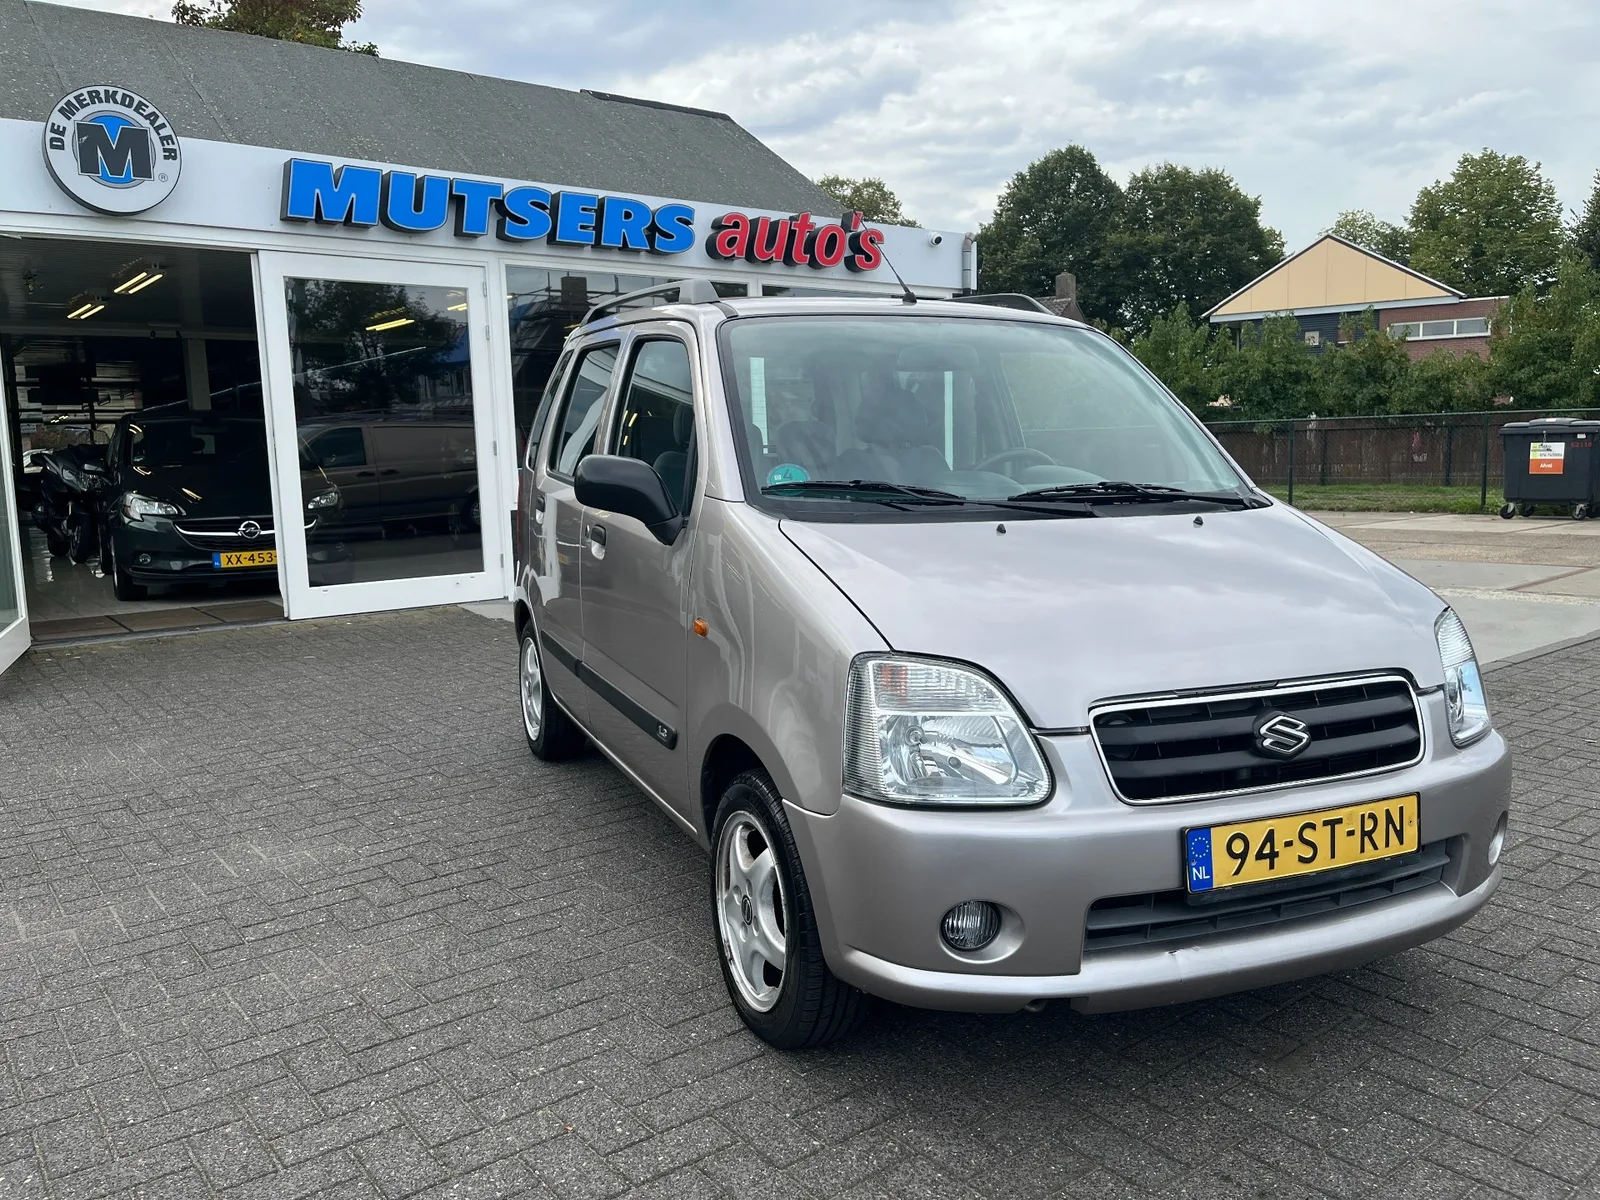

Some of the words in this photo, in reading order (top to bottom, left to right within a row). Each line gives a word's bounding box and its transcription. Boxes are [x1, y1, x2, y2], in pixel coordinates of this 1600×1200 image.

[50, 122, 67, 151] DE
[57, 89, 178, 162] MERKDEALER
[283, 158, 696, 254] MUTSERS
[706, 210, 885, 272] auto's
[225, 552, 278, 566] XX-453-
[1225, 805, 1405, 877] 94-ST-RN
[1191, 865, 1211, 881] NL
